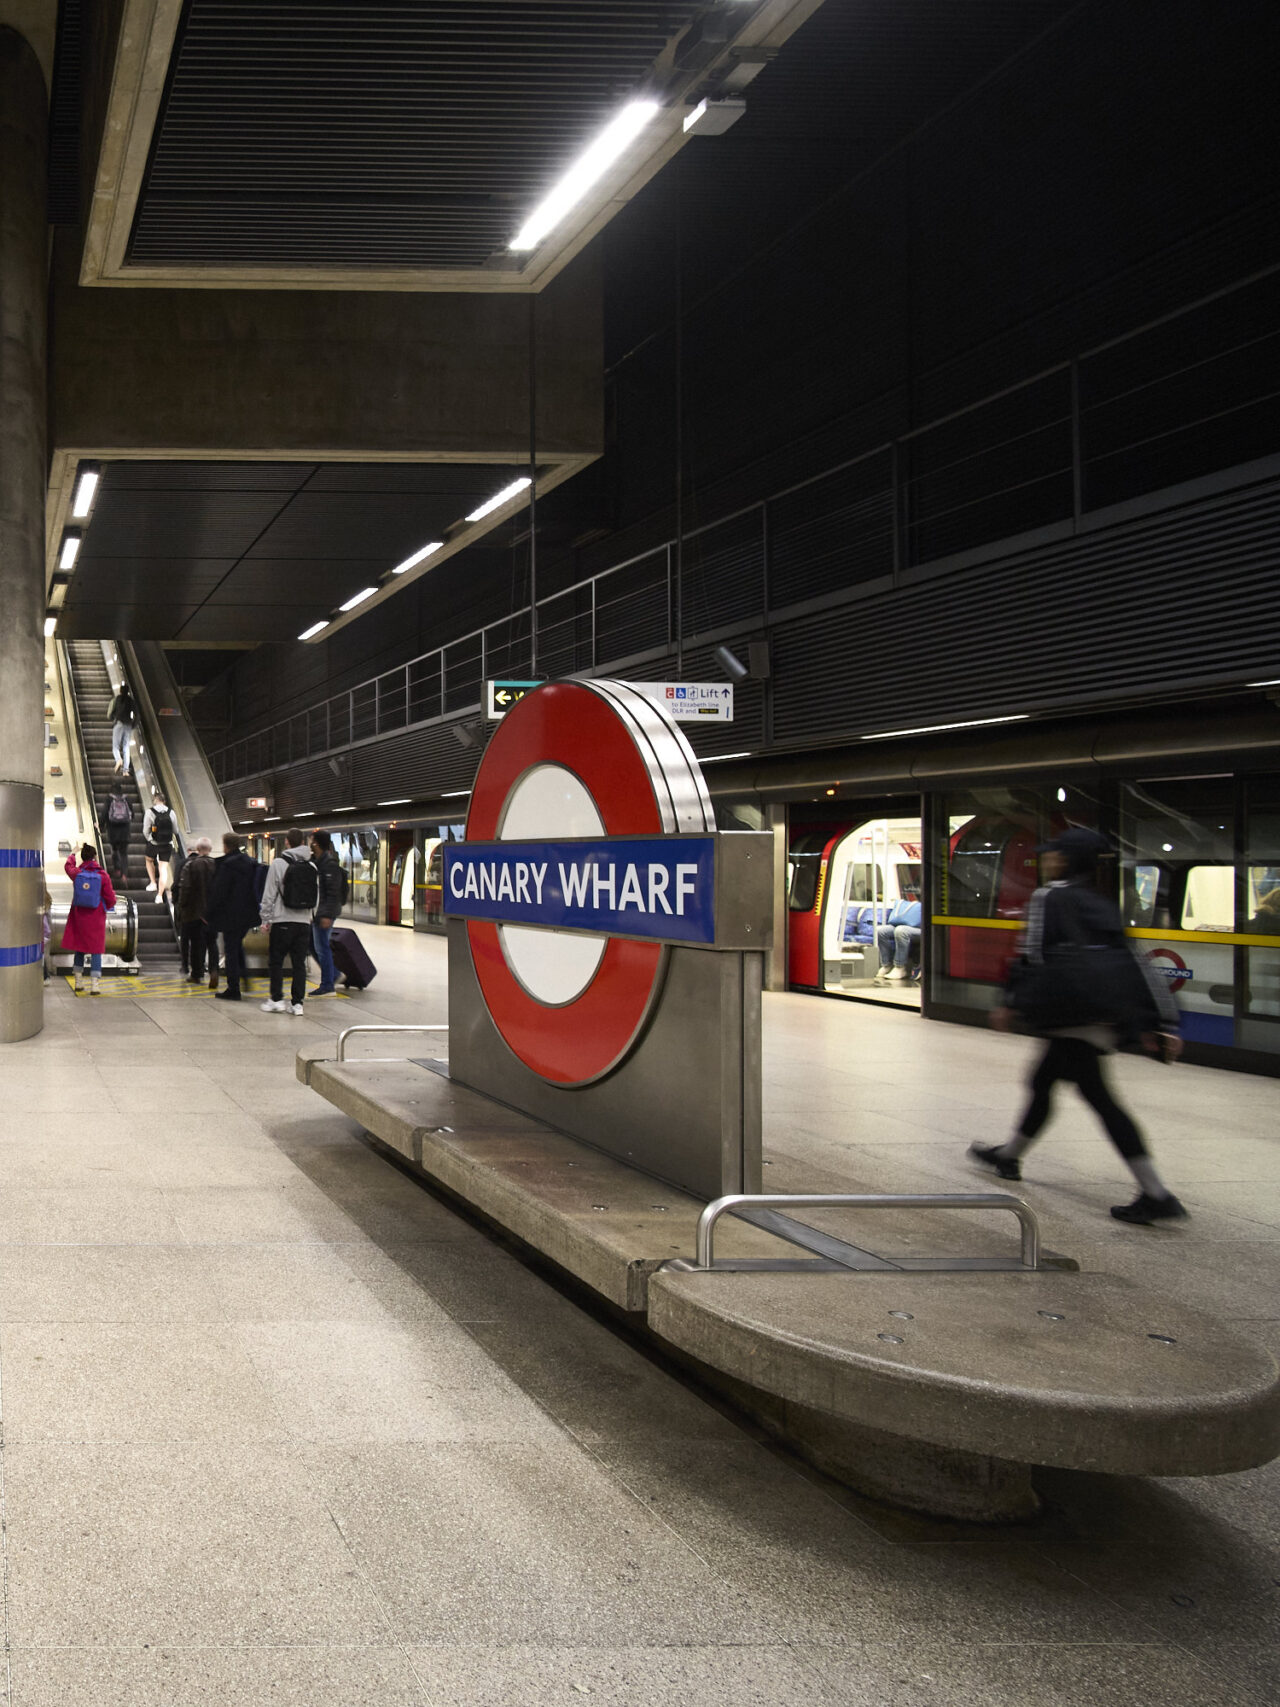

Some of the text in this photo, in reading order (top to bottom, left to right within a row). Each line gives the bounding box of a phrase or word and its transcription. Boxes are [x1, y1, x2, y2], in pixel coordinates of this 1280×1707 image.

[700, 688, 719, 698] Lift
[449, 861, 698, 916] CANARY WHARF
